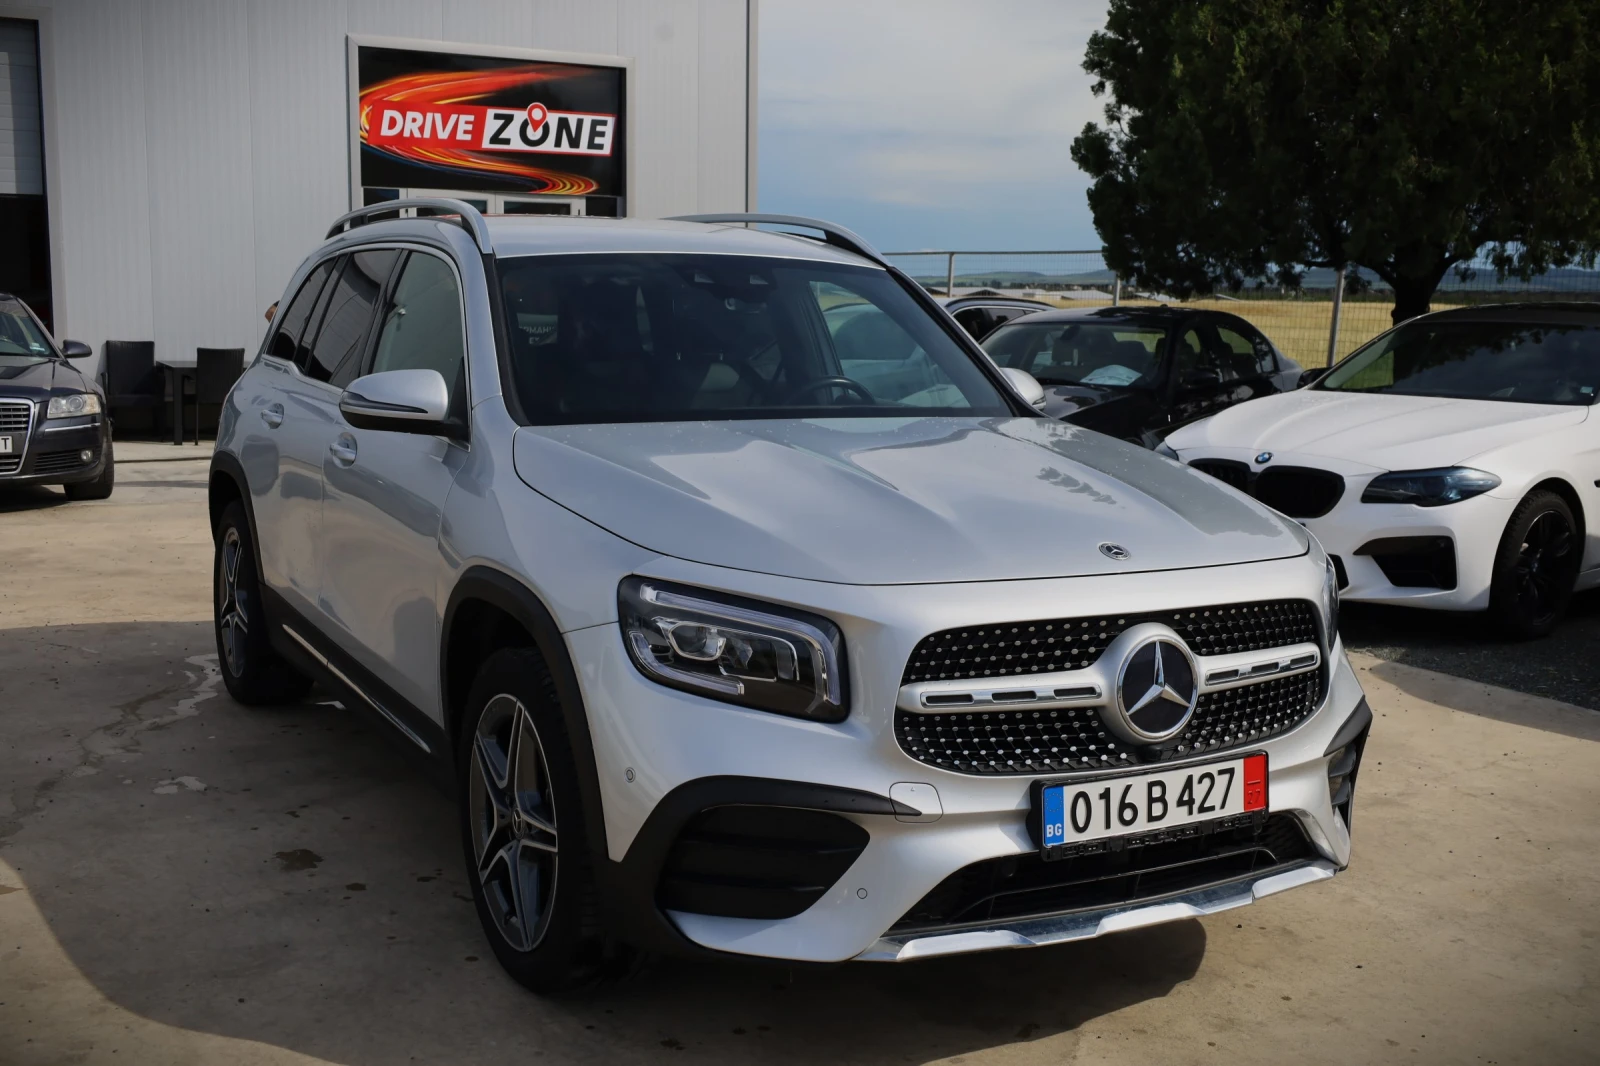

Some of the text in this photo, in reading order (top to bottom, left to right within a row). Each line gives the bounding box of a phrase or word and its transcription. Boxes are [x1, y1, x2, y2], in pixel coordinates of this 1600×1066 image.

[380, 108, 608, 150] DRIVE ZONE
[1046, 823, 1062, 838] BG
